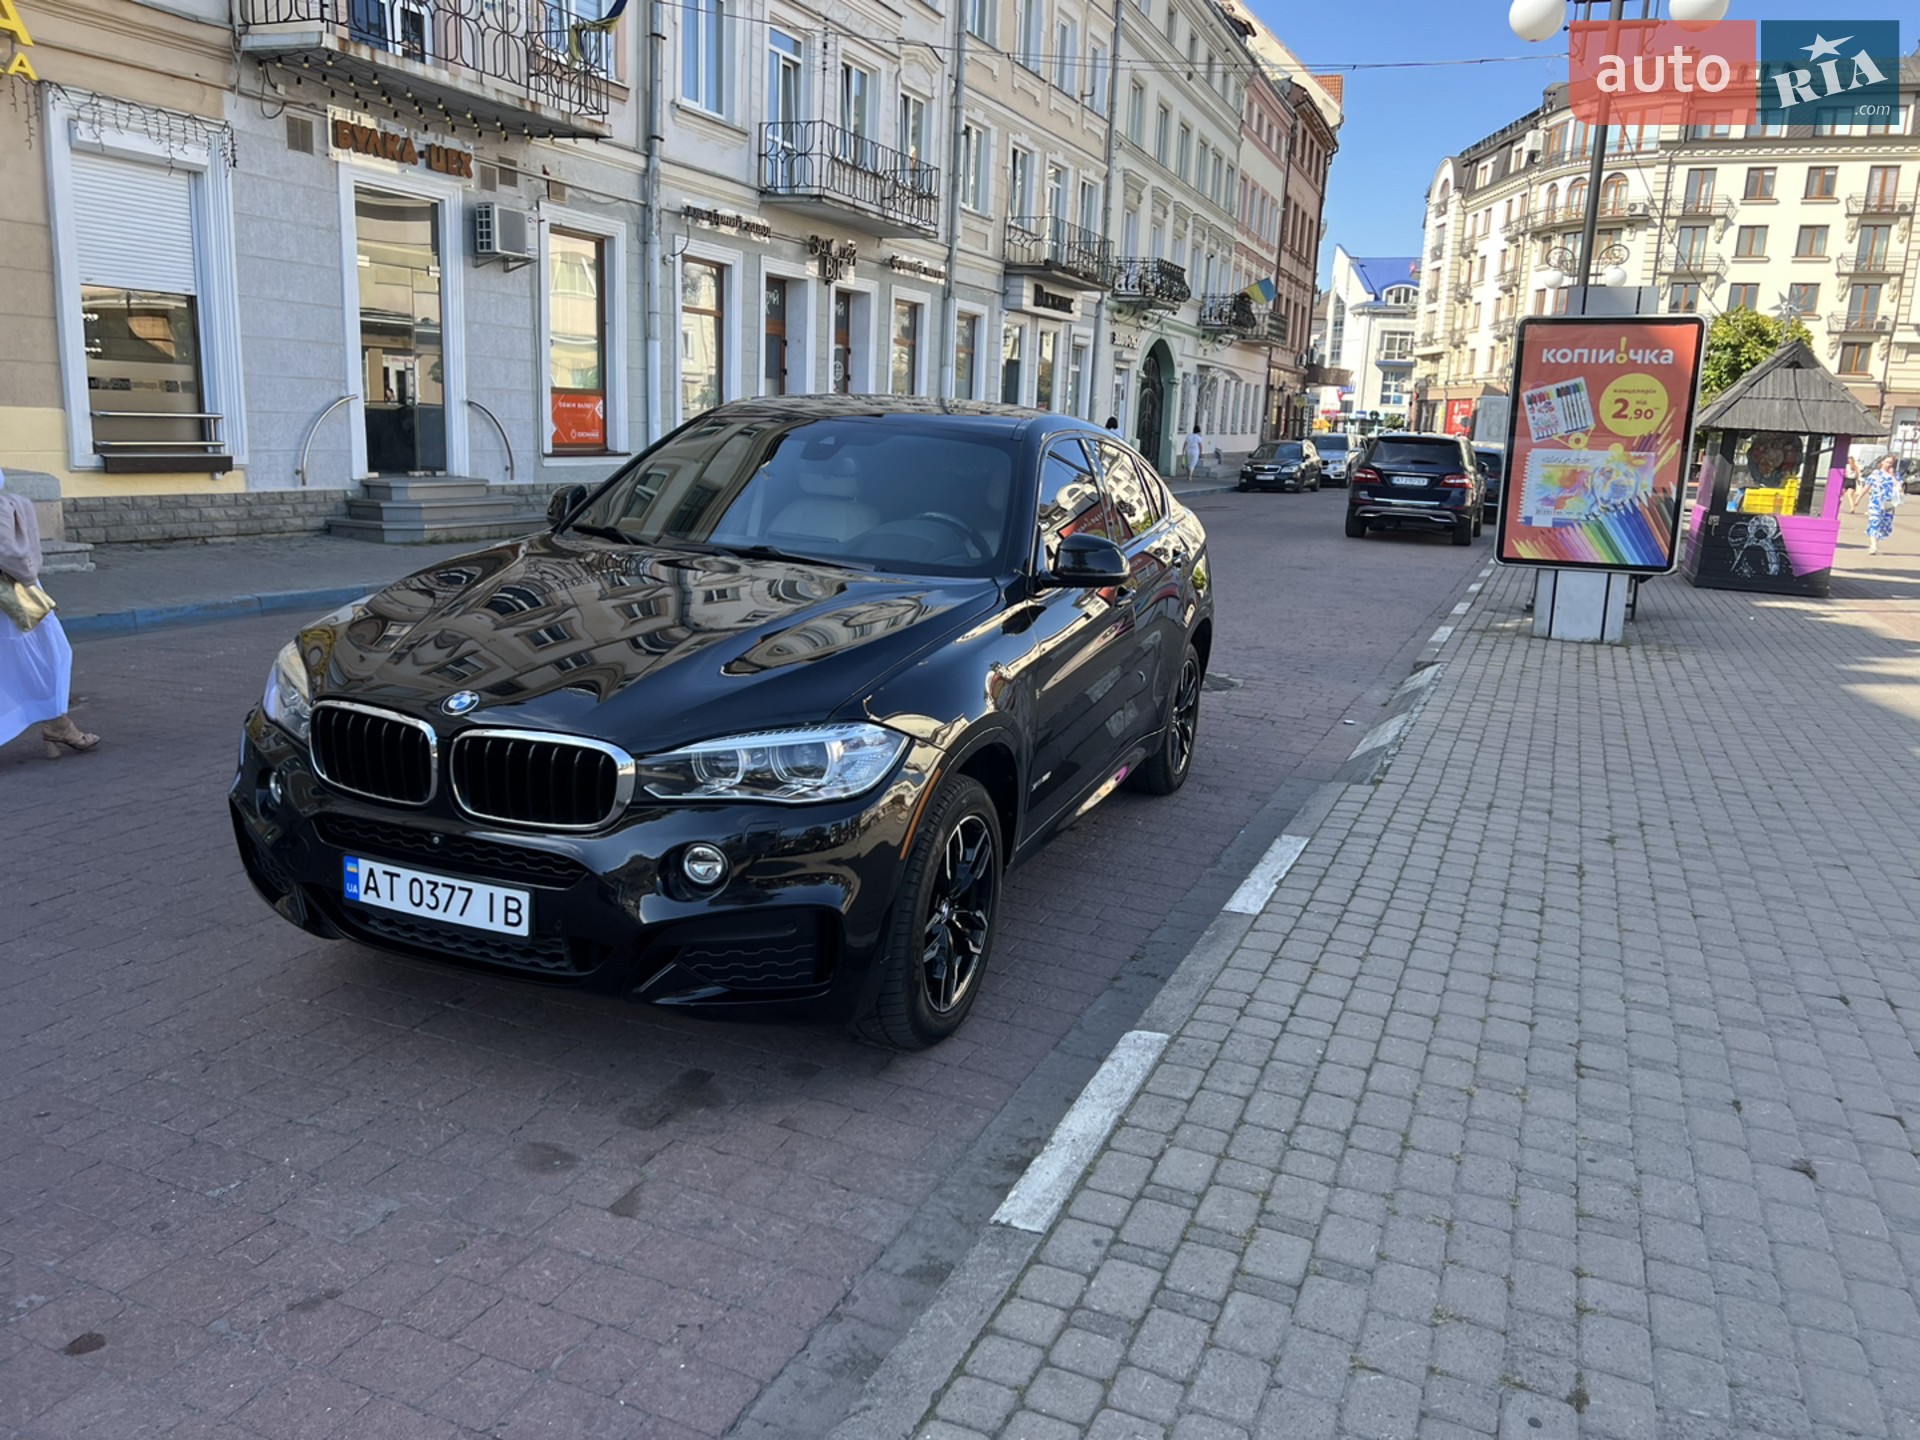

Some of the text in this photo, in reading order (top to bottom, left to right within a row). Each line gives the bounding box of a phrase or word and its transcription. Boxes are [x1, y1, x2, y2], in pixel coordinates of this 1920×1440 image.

[1612, 398, 1654, 421] 2,90
[346, 883, 358, 894] UA
[363, 867, 523, 928] AT 0377 IB
